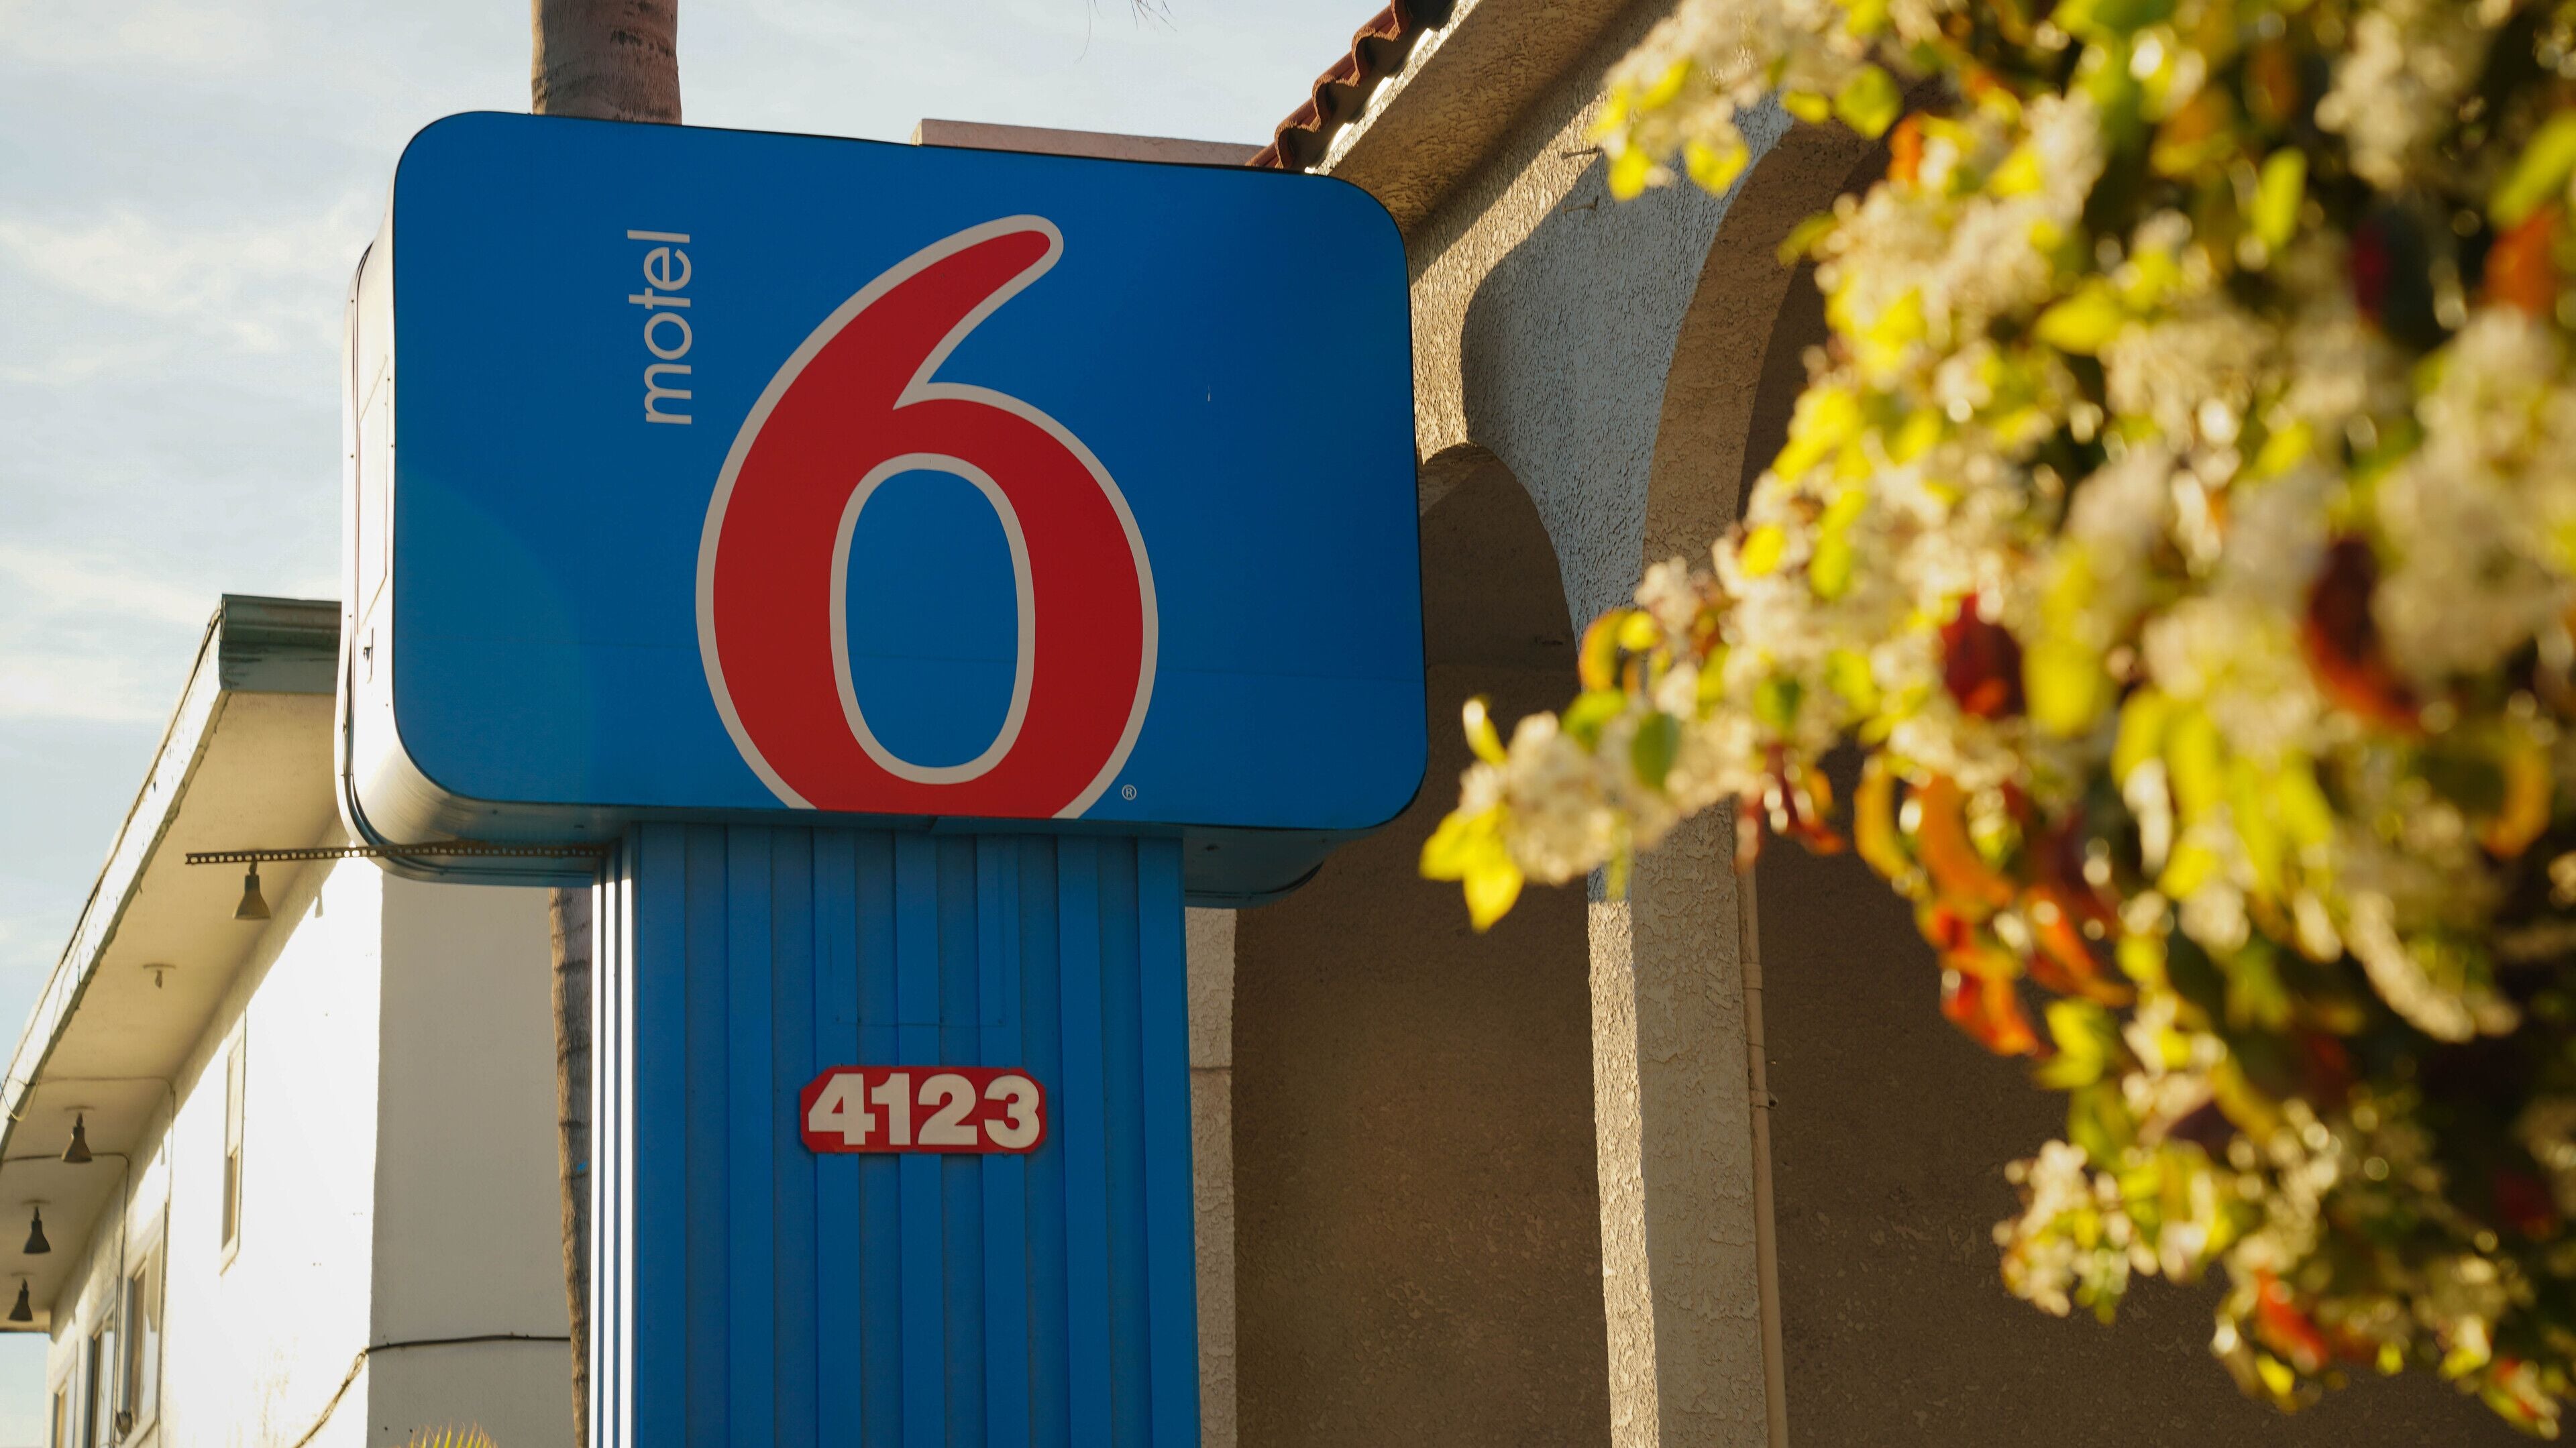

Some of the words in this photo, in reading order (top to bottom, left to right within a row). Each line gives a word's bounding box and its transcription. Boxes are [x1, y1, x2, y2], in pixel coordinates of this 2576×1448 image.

[627, 229, 692, 425] motel
[696, 215, 1158, 819] 6
[808, 1072, 1040, 1149] 4123
